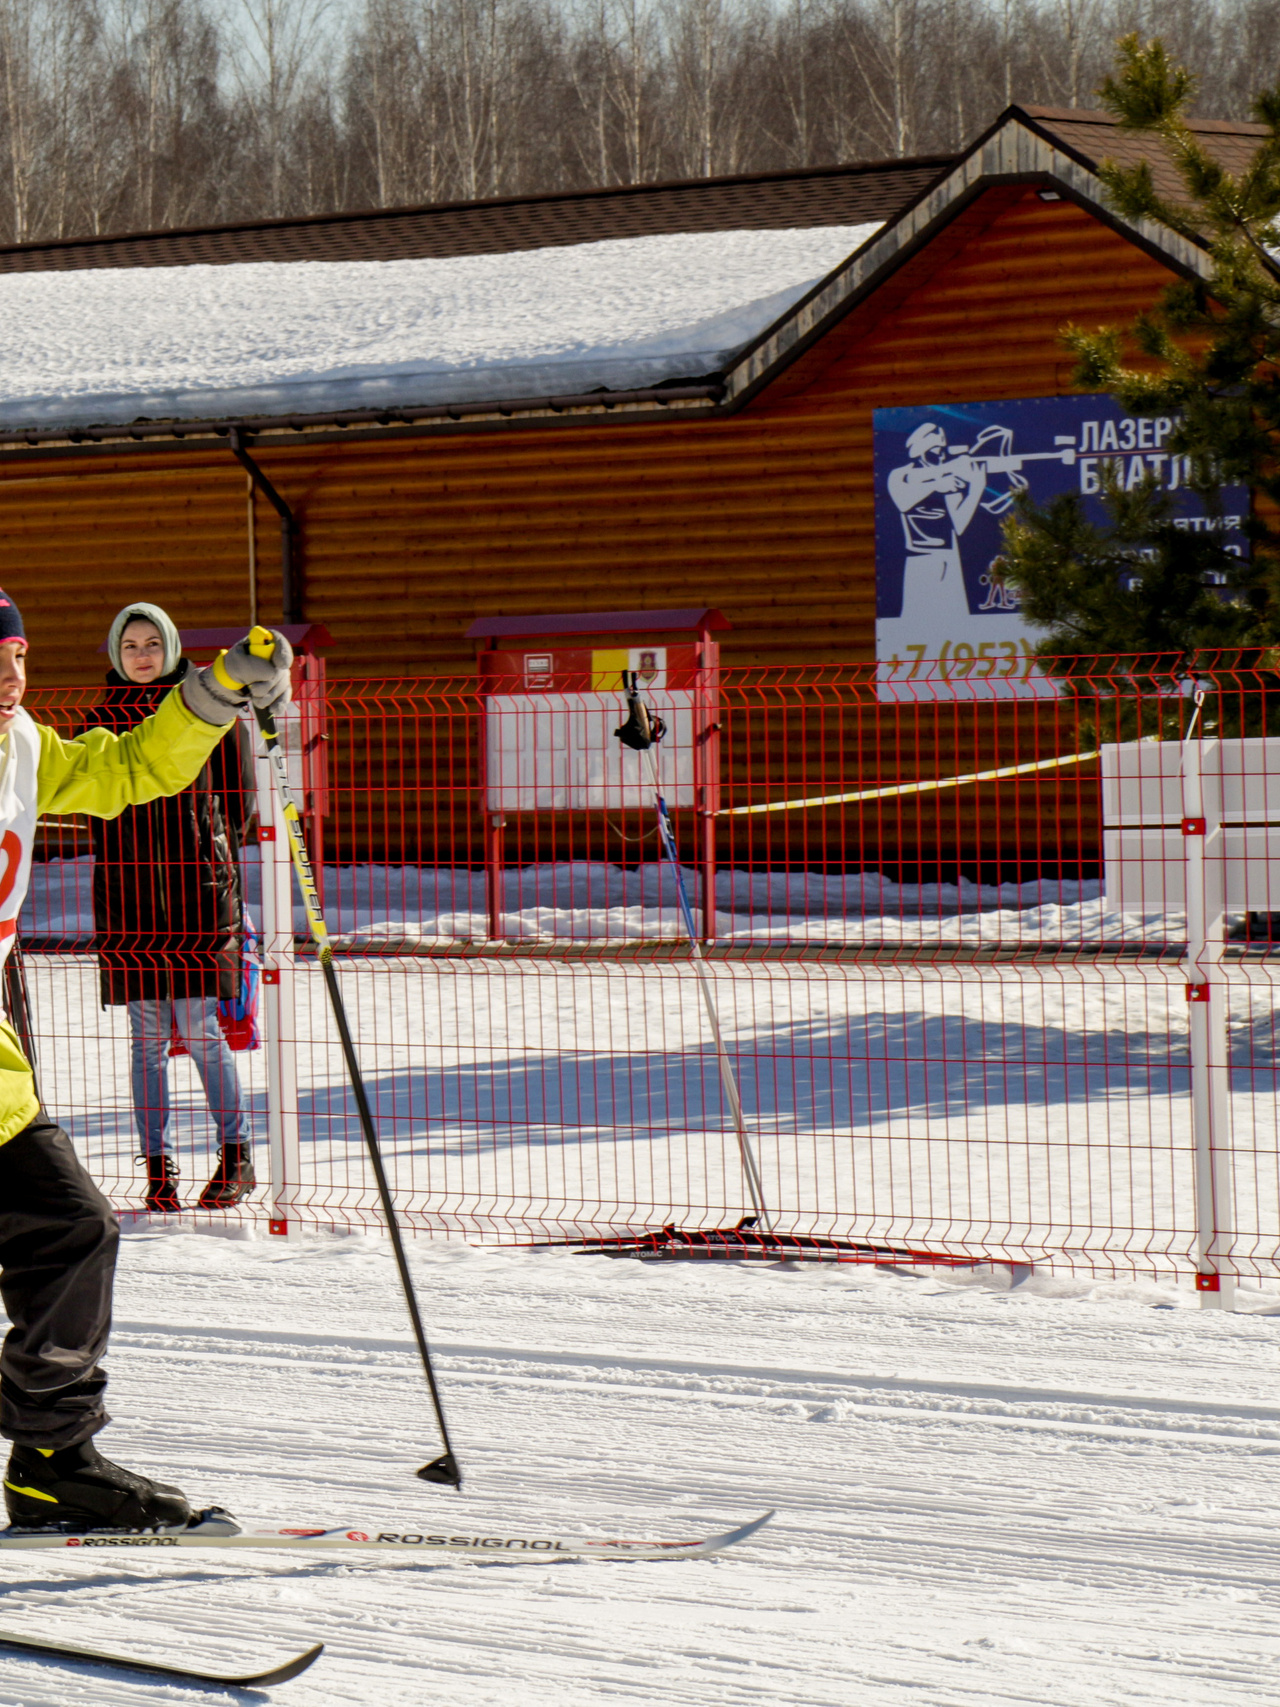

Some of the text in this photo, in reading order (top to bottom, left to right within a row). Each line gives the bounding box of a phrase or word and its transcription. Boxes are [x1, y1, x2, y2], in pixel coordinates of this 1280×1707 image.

[887, 644, 927, 679] +7
[290, 819, 324, 921] SPORTER
[81, 1537, 181, 1548] ROSSIGNOL
[376, 1532, 571, 1551] ROSSIGNOL
